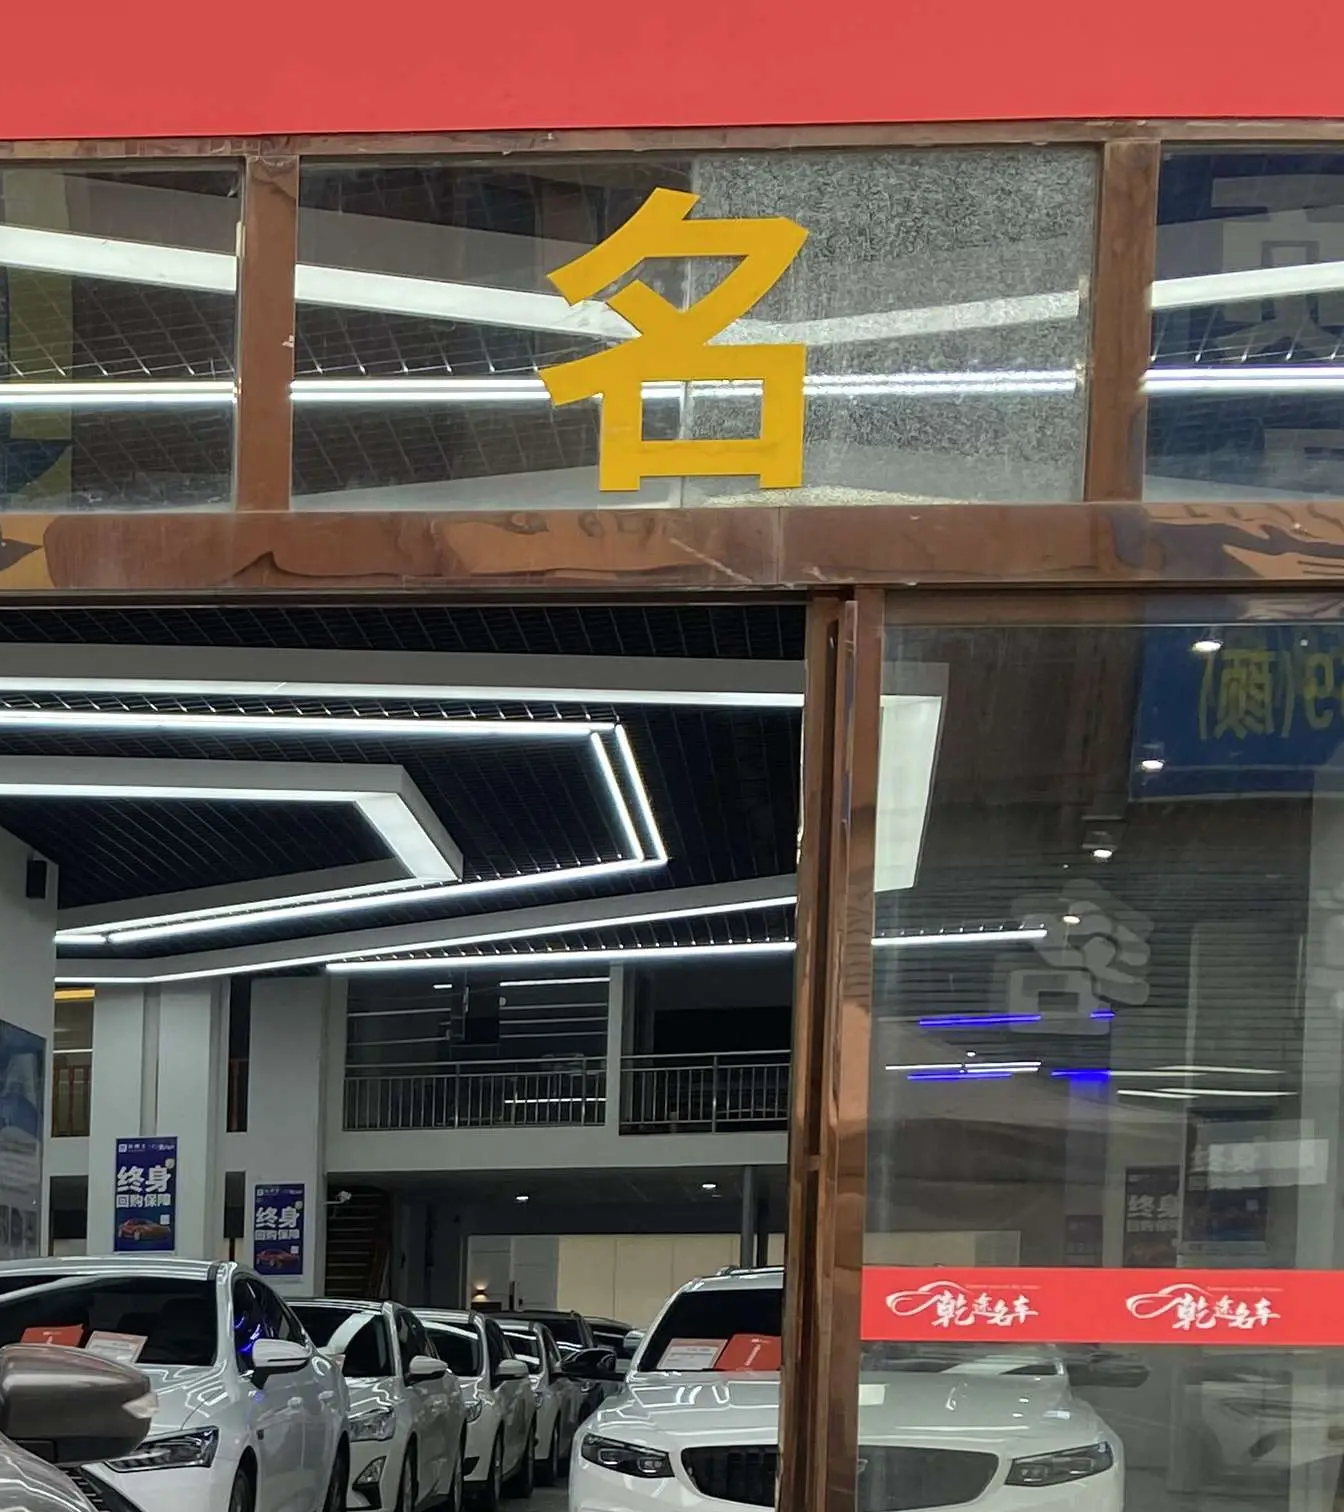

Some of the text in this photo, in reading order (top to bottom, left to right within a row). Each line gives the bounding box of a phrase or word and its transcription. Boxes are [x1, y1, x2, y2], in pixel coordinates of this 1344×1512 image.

[538, 185, 810, 492] 名
[116, 1165, 172, 1193] 终身
[115, 1193, 172, 1208] 回购保障
[255, 1205, 300, 1228] 终身
[254, 1229, 300, 1241] 回购保障
